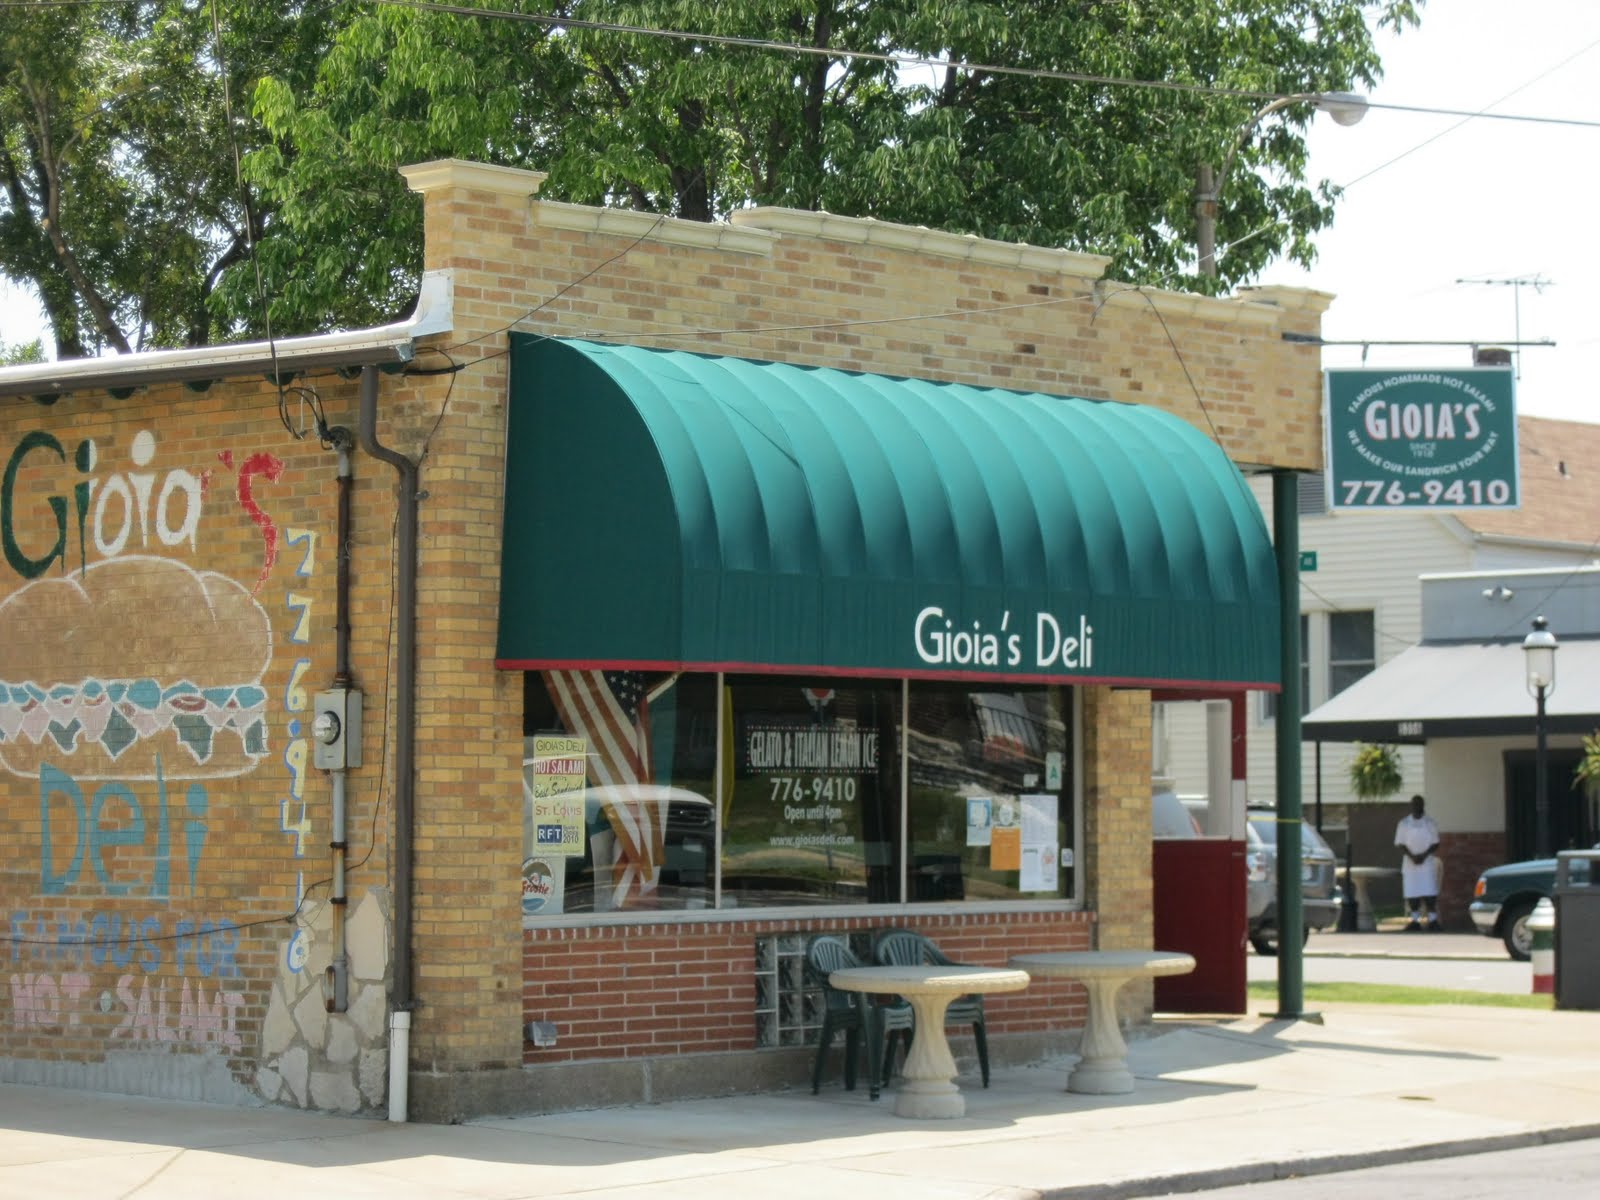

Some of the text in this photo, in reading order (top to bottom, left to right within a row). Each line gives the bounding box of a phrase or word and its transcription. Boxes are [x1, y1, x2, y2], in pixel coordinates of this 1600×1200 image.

[1348, 373, 1496, 414] FAMOUS HOMEMADE HOT SALAMI
[1365, 400, 1480, 440] GIOIA'S
[1348, 429, 1499, 476] WE MAKE OUR SANDWICH YOUR WAY
[1409, 442, 1437, 450] SINCE
[1341, 479, 1510, 505] 776-9410
[914, 606, 1093, 668] Gioia's Deli
[535, 759, 584, 774] HOT SALAMI
[750, 731, 876, 768] GELATO & ITALIAN LEMON ICE
[770, 777, 856, 801] 776-9410
[40, 751, 209, 904] Deli
[783, 804, 806, 824] Open
[806, 804, 825, 819] until
[538, 828, 561, 840] RFT
[769, 834, 855, 848] www.gioiasdeli.com
[10, 911, 241, 977] FAMOUS FOR
[10, 973, 92, 1029] HOT
